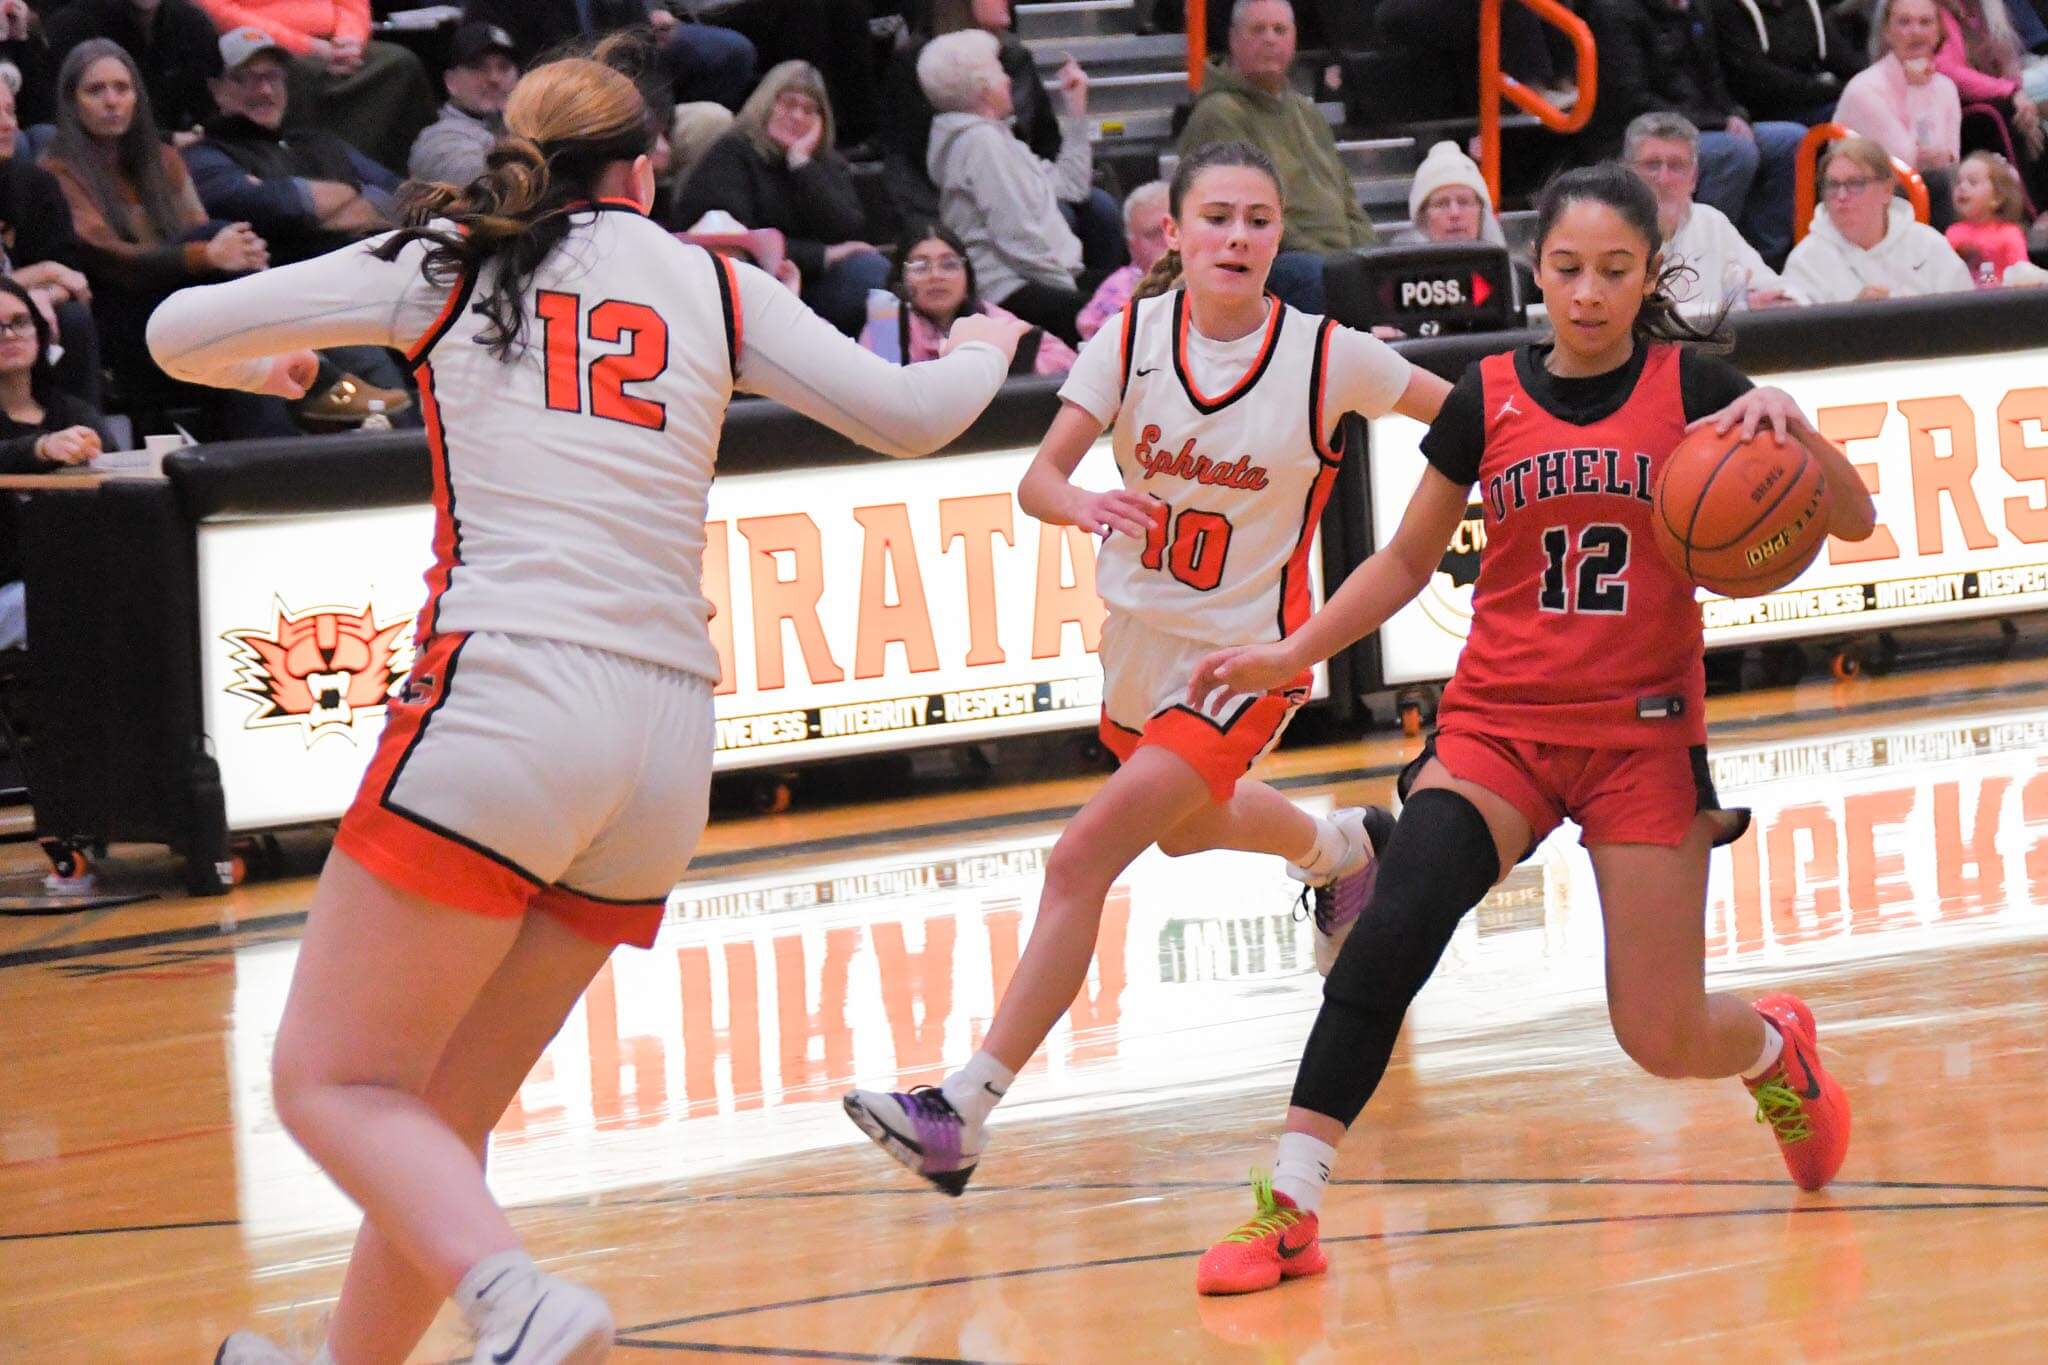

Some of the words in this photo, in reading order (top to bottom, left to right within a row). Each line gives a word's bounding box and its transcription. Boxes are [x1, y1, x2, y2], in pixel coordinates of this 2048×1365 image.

[1401, 279, 1467, 307] POSS.
[535, 288, 668, 432] 12
[1135, 424, 1269, 491] Ephrata
[1141, 493, 1233, 591] 10
[1538, 522, 1632, 615] 12
[1703, 585, 1865, 629] COMPETITIVENESS
[1876, 573, 1966, 609] INTEGRITY
[820, 697, 930, 737] INTEGRITY
[943, 683, 1036, 723] RESPECT
